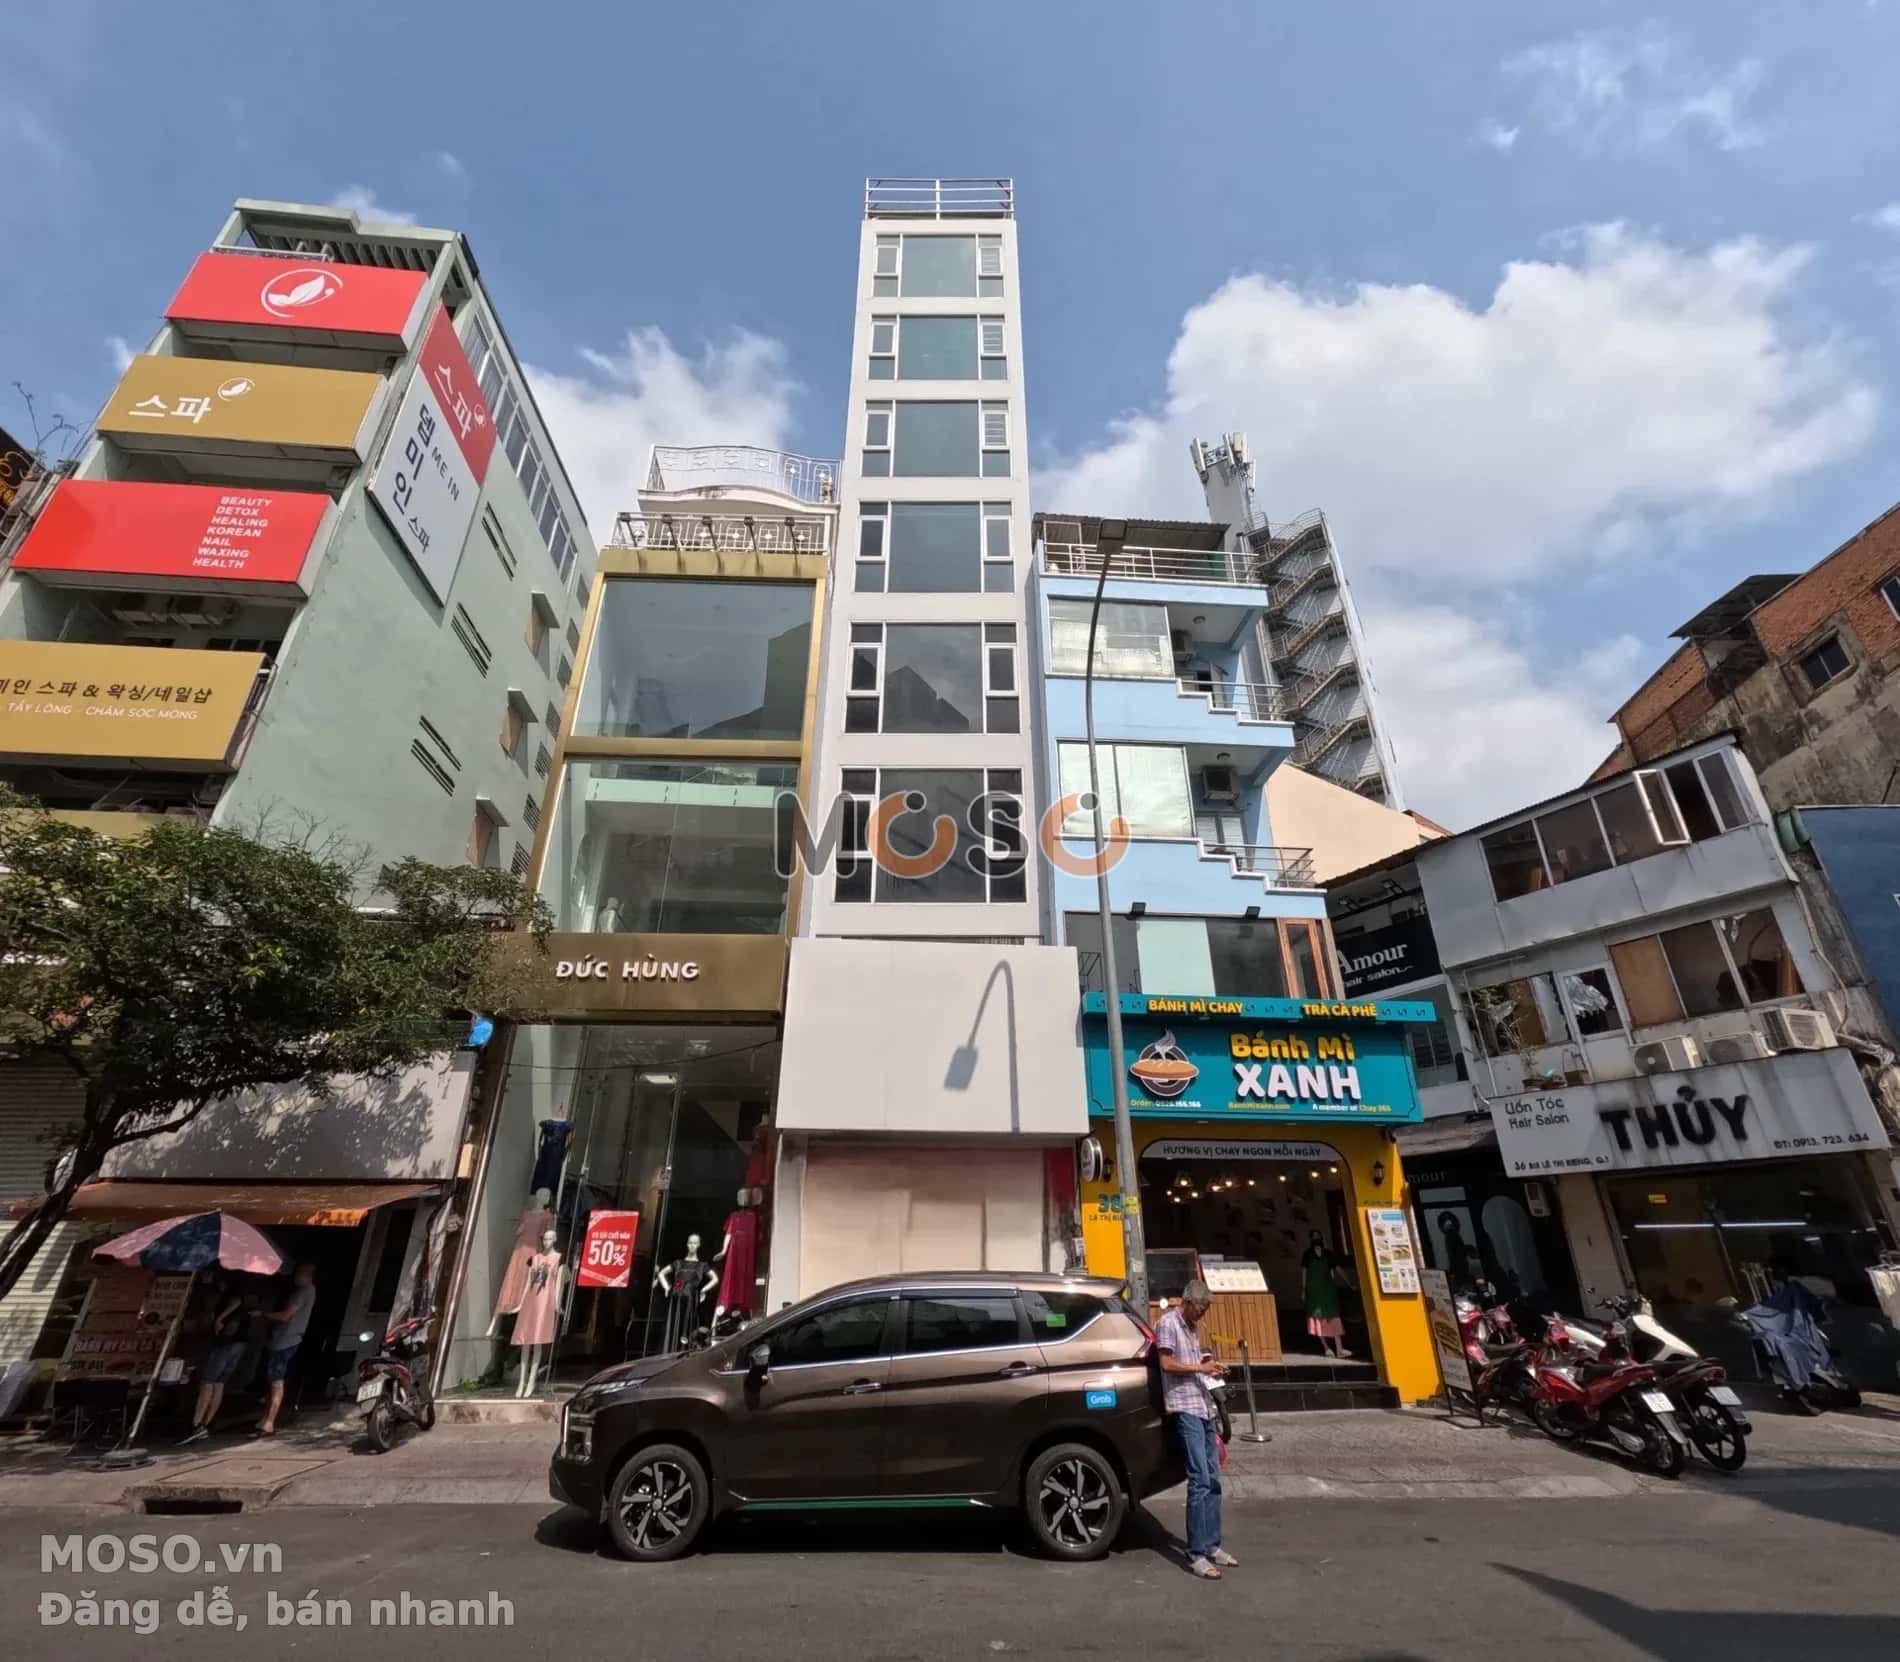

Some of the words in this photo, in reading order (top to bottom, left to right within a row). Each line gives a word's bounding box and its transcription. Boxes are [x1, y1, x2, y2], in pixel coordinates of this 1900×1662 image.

[128, 395, 212, 424] 스파
[434, 363, 471, 440] 스파
[432, 447, 448, 480] ME
[448, 477, 460, 502] IN
[220, 496, 273, 507] BEAUTY
[216, 506, 260, 516] DETOX
[211, 516, 269, 527] HEALING
[207, 526, 263, 537] KOREAN
[407, 516, 430, 553] 스파
[201, 536, 231, 546] NAIL
[197, 547, 250, 558] WAXING
[192, 557, 245, 568] HEALTH
[36, 680, 77, 697] 스파
[82, 684, 99, 698] &
[556, 953, 609, 978] ĐỨC
[622, 953, 699, 978] HÙNG
[1336, 944, 1408, 974] Amour
[1367, 966, 1401, 981] salon
[1148, 999, 1187, 1012] BÁNH
[1190, 998, 1205, 1012] MÌ
[1208, 1001, 1244, 1014] CHAY
[1303, 1003, 1329, 1016] TRÀ
[1332, 1003, 1350, 1016] CÀ
[1352, 1003, 1377, 1017] PHÊ
[1230, 1029, 1310, 1059] Bánh
[1318, 1033, 1356, 1060] Mì
[1234, 1063, 1362, 1100] XANH
[1509, 1118, 1532, 1129] Hair
[1535, 1113, 1569, 1126] Salon
[1598, 1086, 1749, 1151] THỦY
[1215, 1146, 1240, 1156] CHAY
[1242, 1147, 1272, 1156] NGON
[1090, 1394, 1112, 1405] Grab
